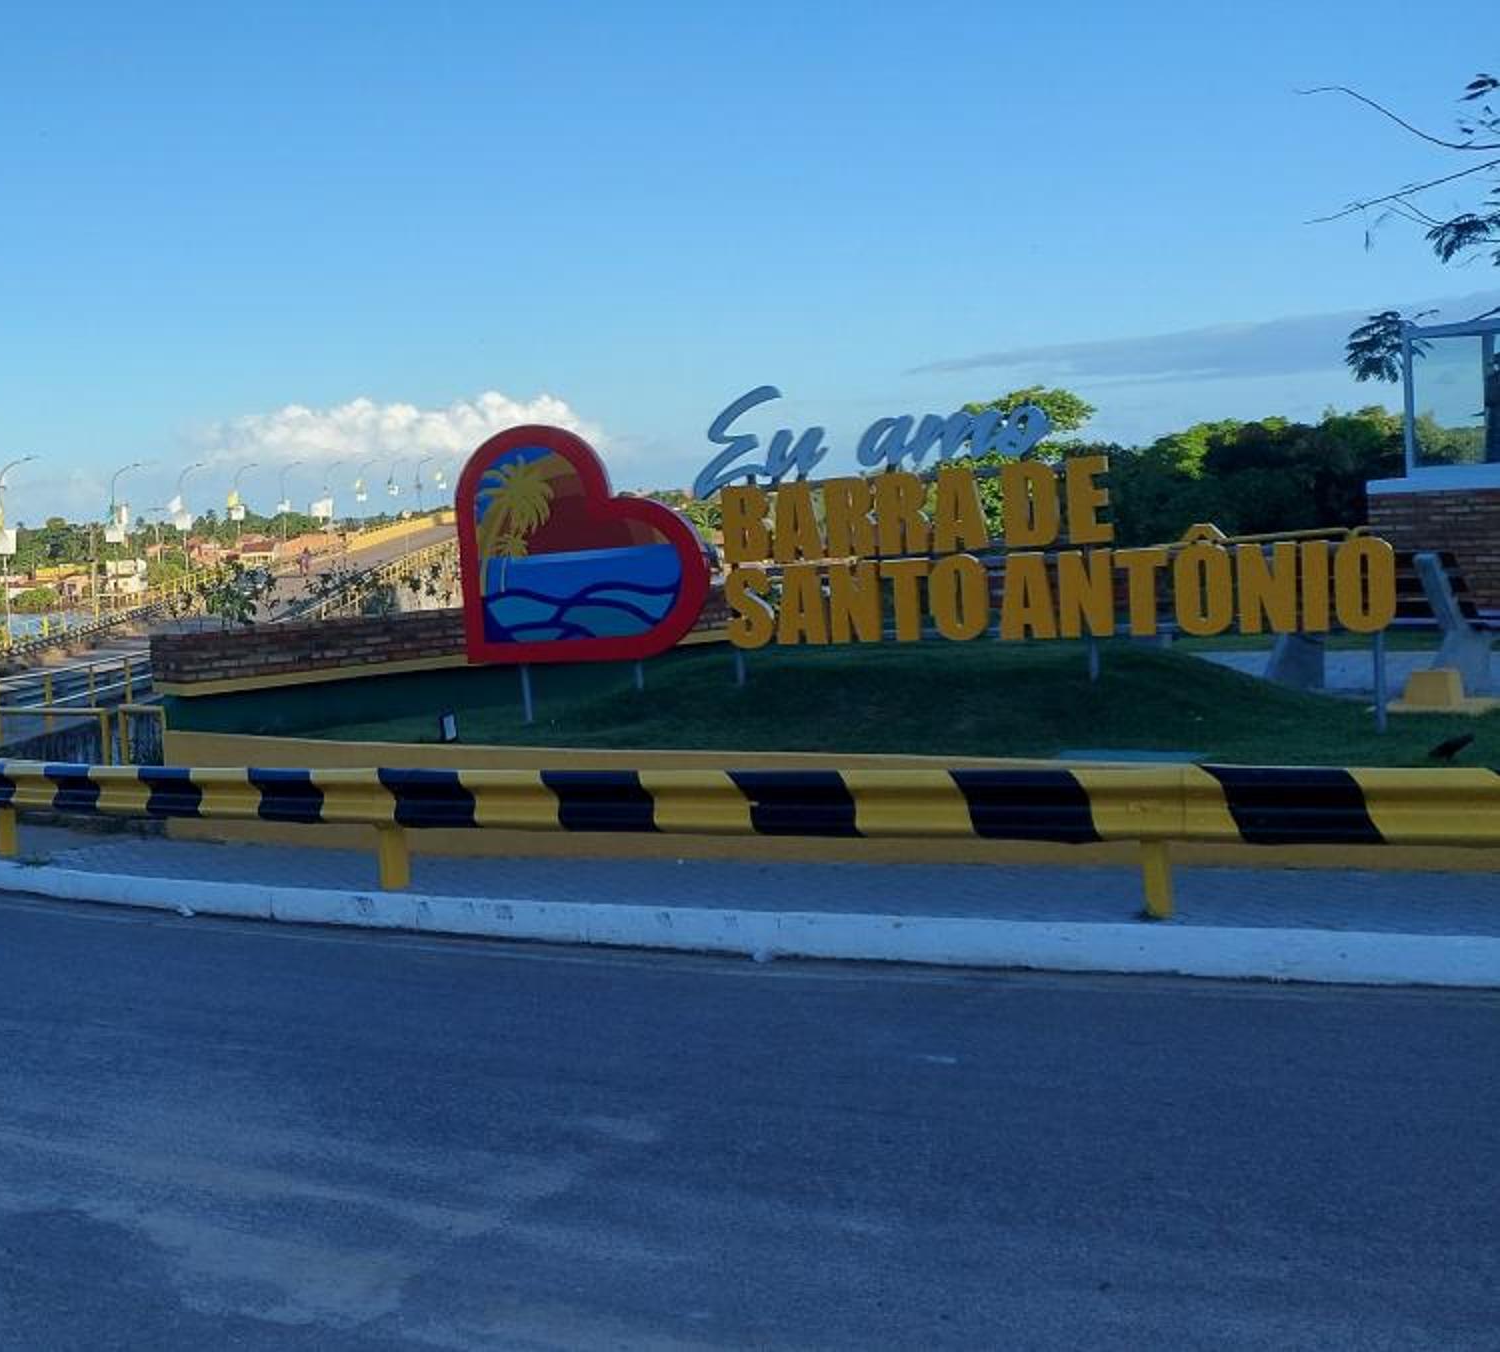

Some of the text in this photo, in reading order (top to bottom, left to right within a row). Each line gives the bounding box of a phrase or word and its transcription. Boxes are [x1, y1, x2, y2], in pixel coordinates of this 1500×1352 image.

[694, 385, 1052, 500] Eu amo
[721, 455, 1115, 563] BARRA DE
[724, 523, 1397, 649] SANTO ANTÔNIO
